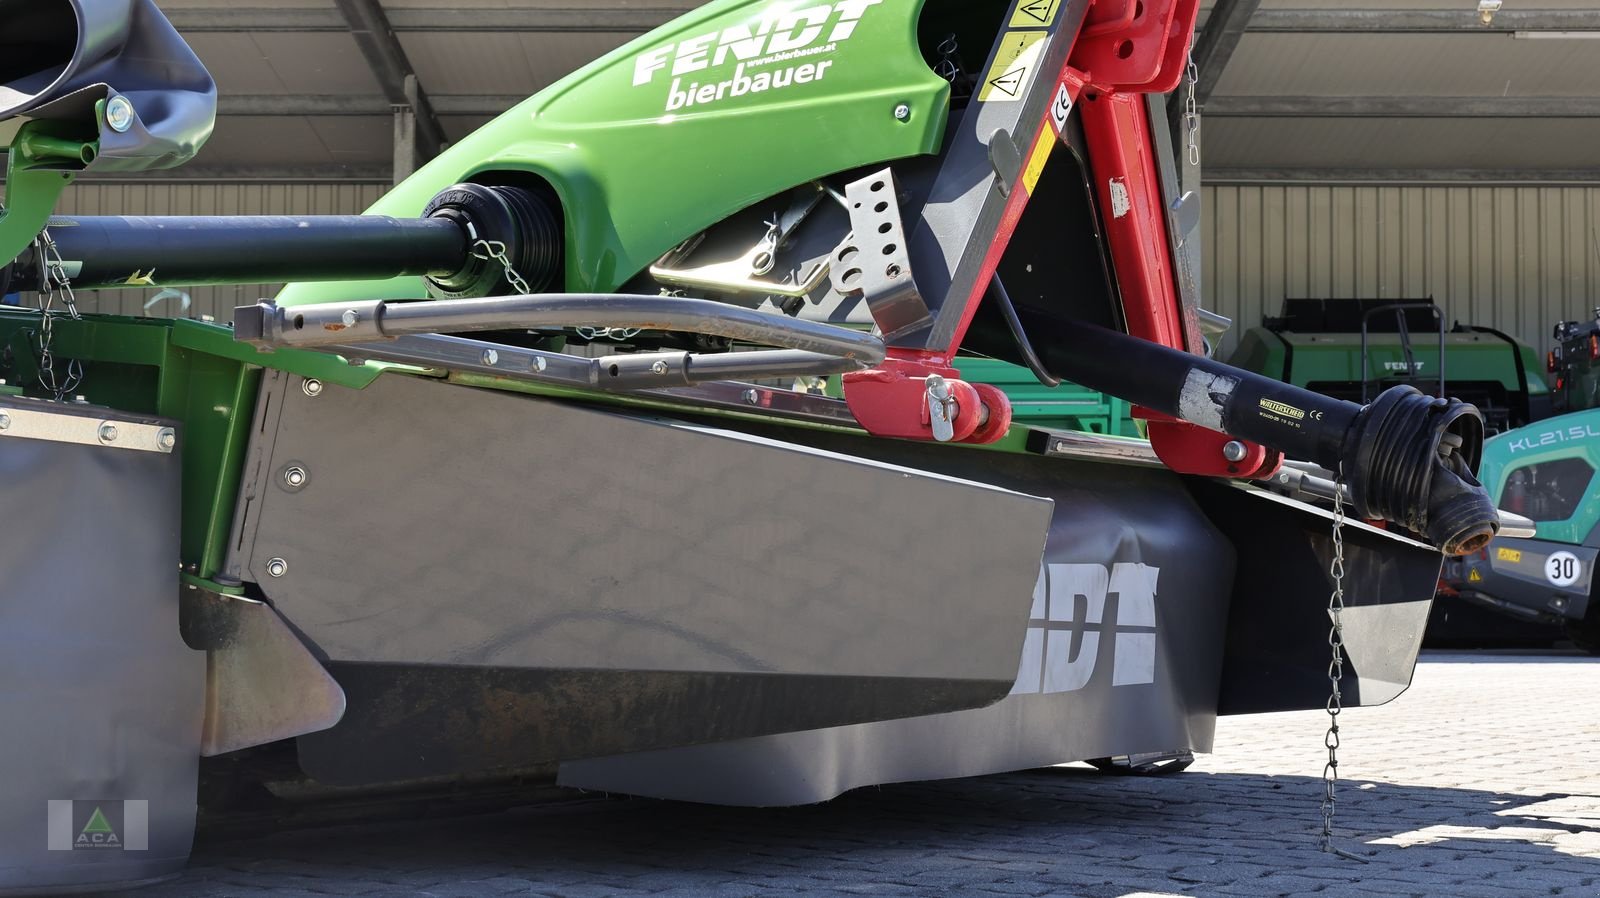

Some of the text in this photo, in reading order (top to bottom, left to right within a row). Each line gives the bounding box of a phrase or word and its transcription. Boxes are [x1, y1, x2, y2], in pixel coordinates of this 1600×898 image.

[632, 0, 884, 87] FENDT
[747, 42, 837, 68] www.bierbauer.at
[665, 60, 833, 112] bierbauer
[1383, 361, 1425, 371] FENT
[1259, 398, 1305, 420] WALTERSCHEID
[1509, 425, 1600, 453] KL21.5L
[1551, 557, 1575, 580] 30
